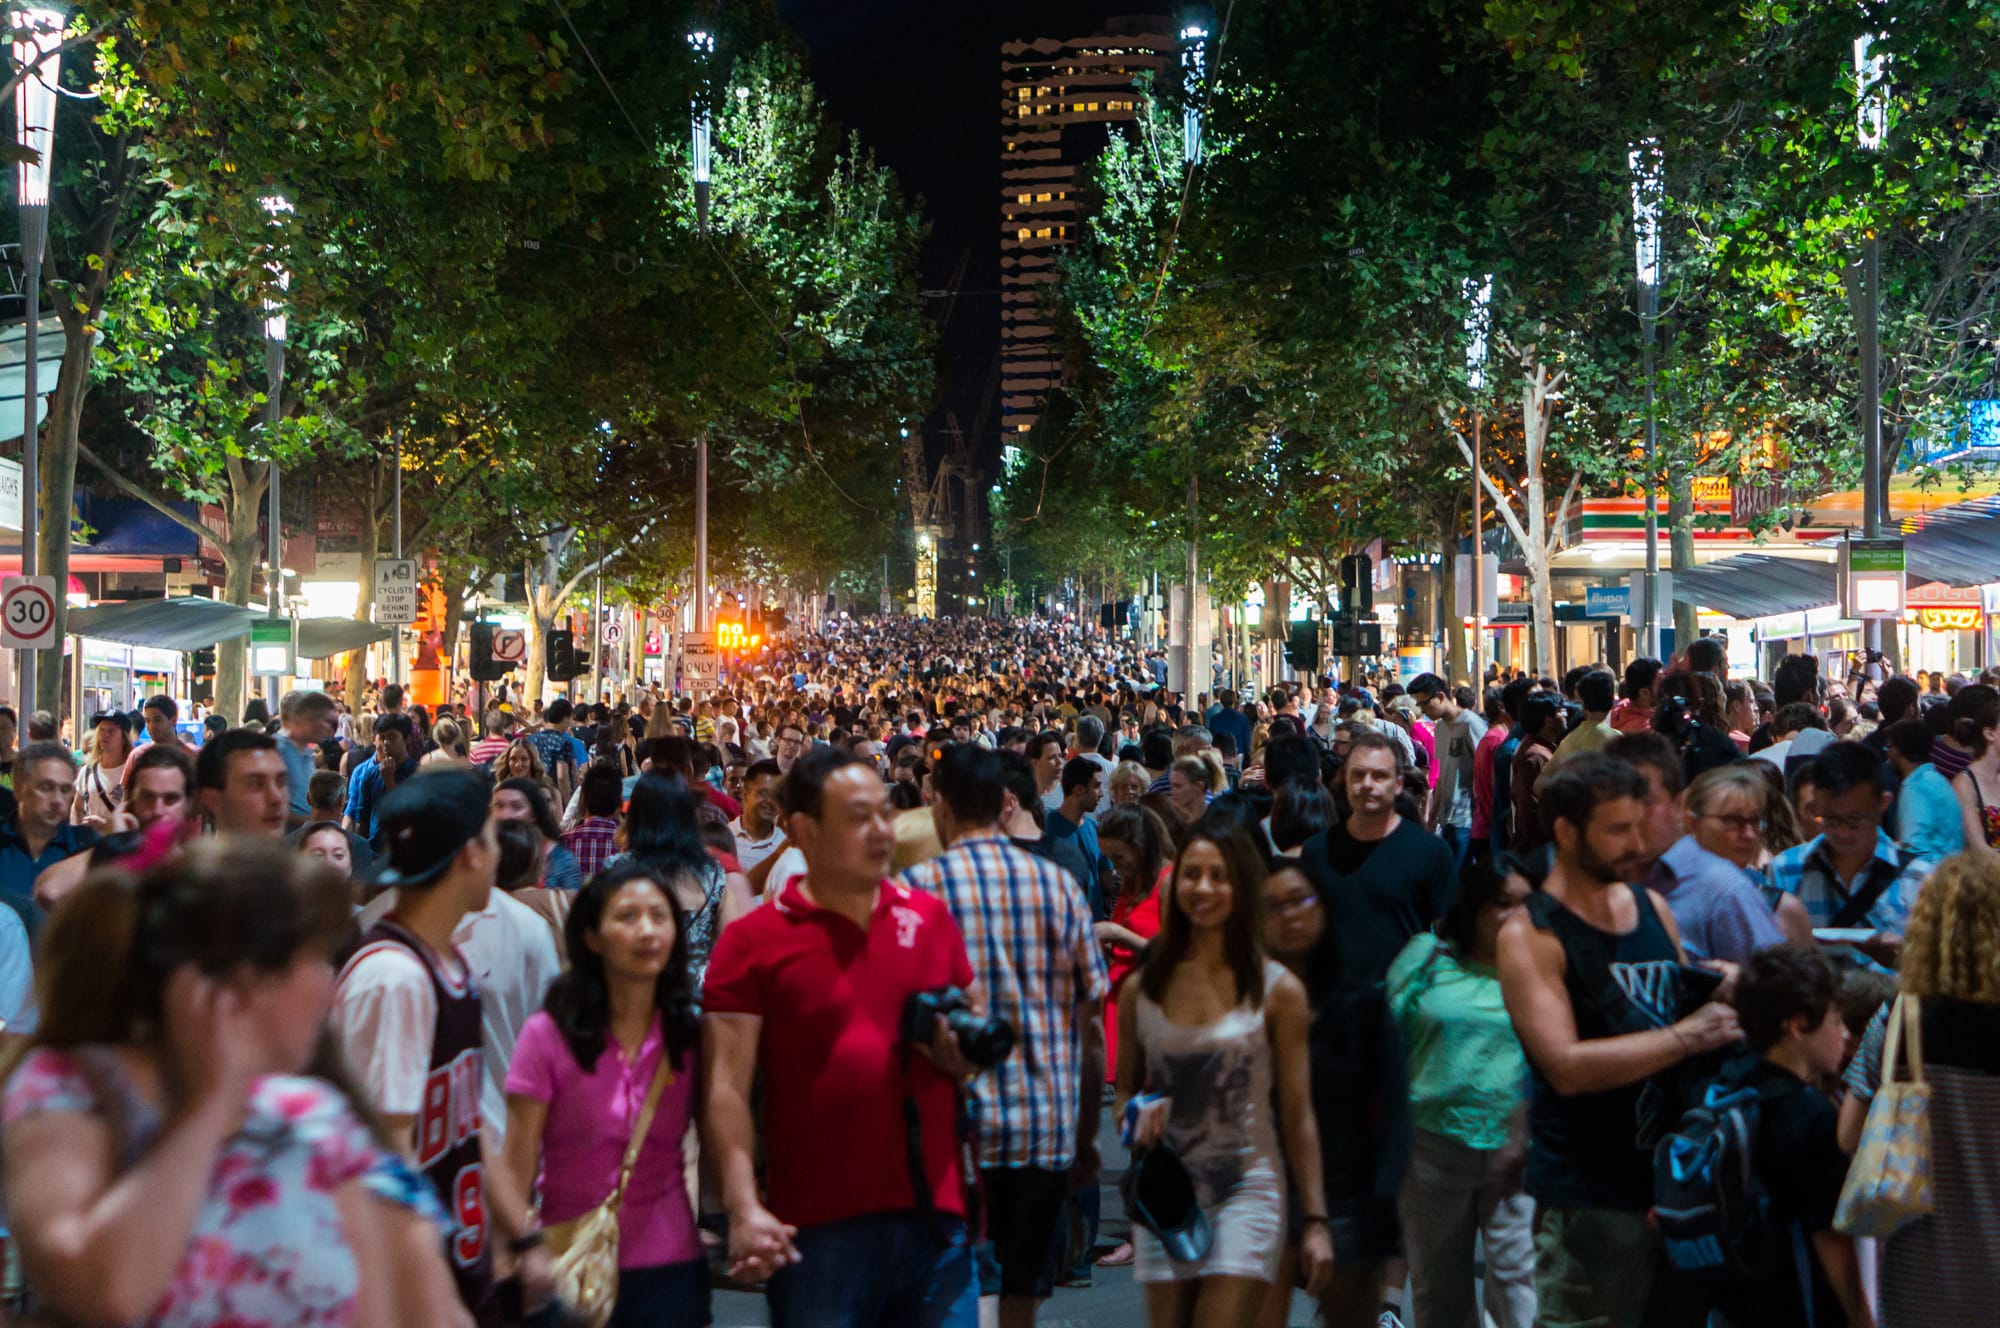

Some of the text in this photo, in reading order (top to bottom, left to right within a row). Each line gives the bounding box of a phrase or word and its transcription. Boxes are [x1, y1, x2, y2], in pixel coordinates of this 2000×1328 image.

[377, 586, 413, 595] CYCLISTS
[386, 595, 405, 603] STOP
[1591, 592, 1624, 604] Bupa
[12, 600, 45, 623] 30
[382, 604, 409, 612] BEHIND
[659, 609, 672, 618] 30
[686, 662, 714, 673] ONLY
[690, 680, 710, 688] END
